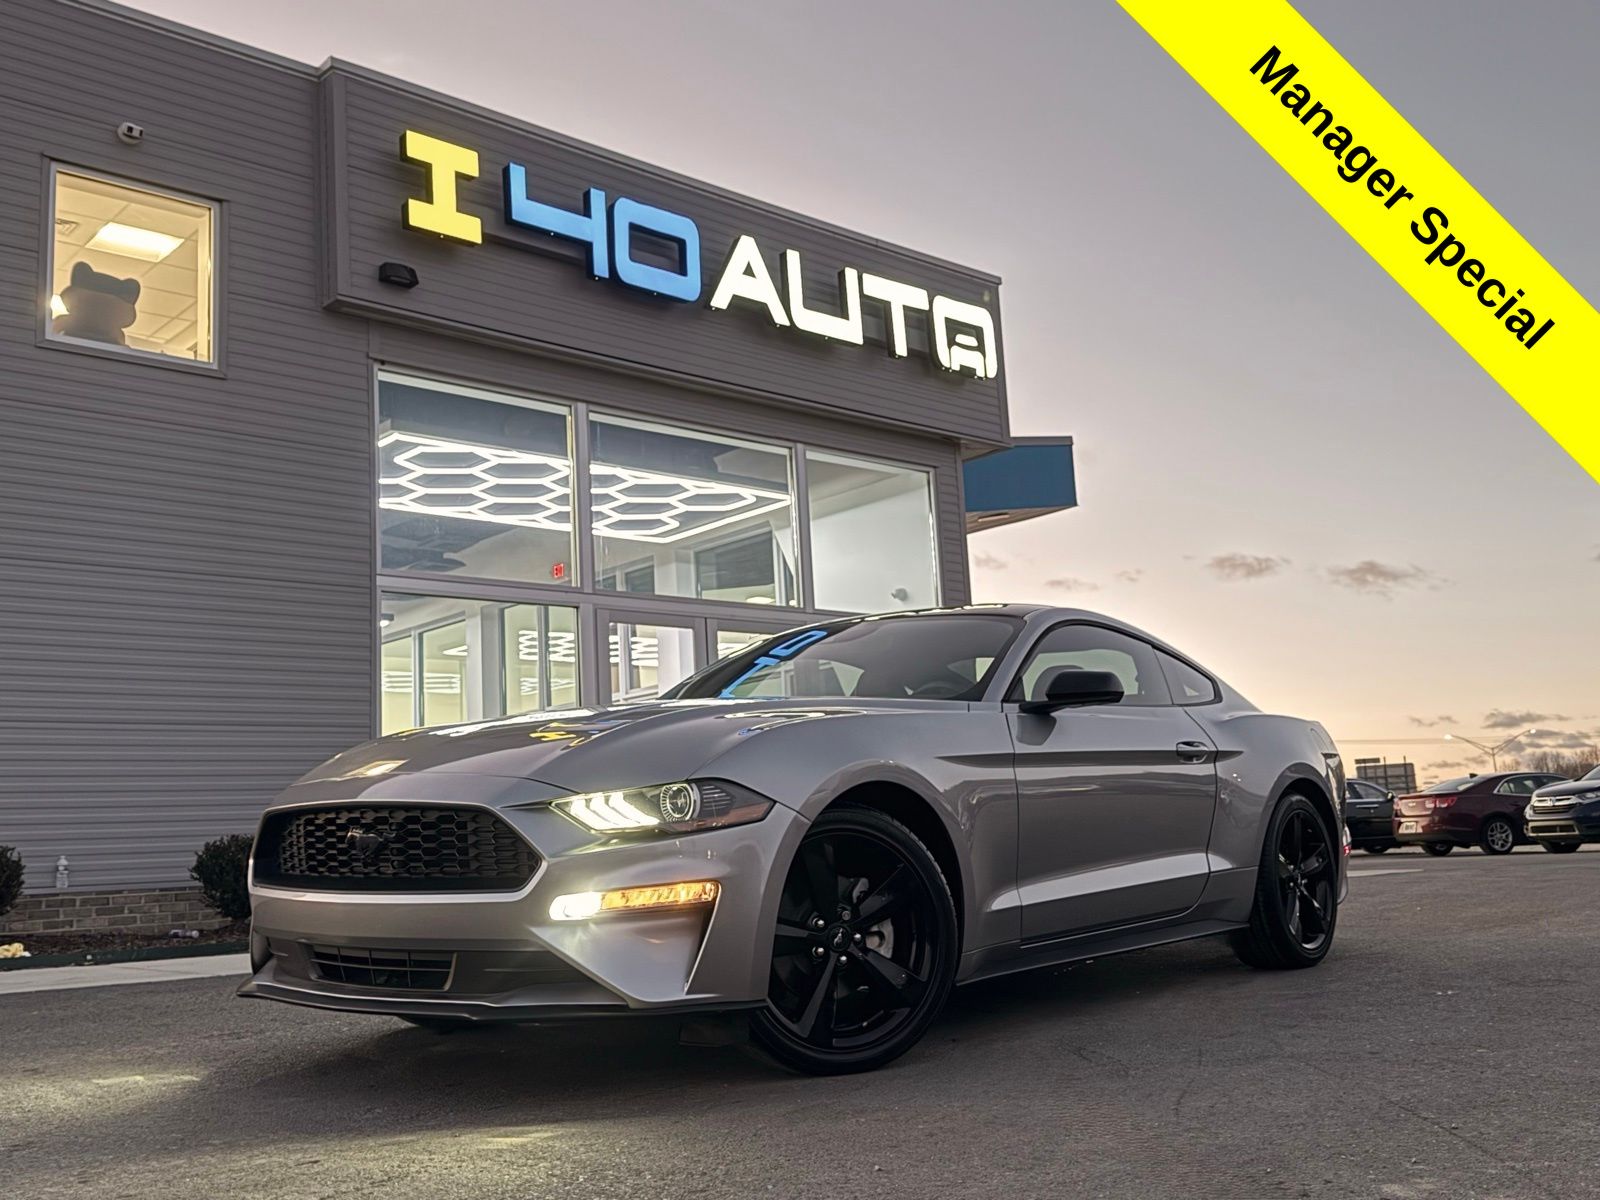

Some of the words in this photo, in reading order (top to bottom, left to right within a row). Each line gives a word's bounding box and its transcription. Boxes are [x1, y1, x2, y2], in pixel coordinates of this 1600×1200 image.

[403, 130, 482, 245] I
[507, 162, 701, 302] 40
[710, 234, 998, 379] AUTO
